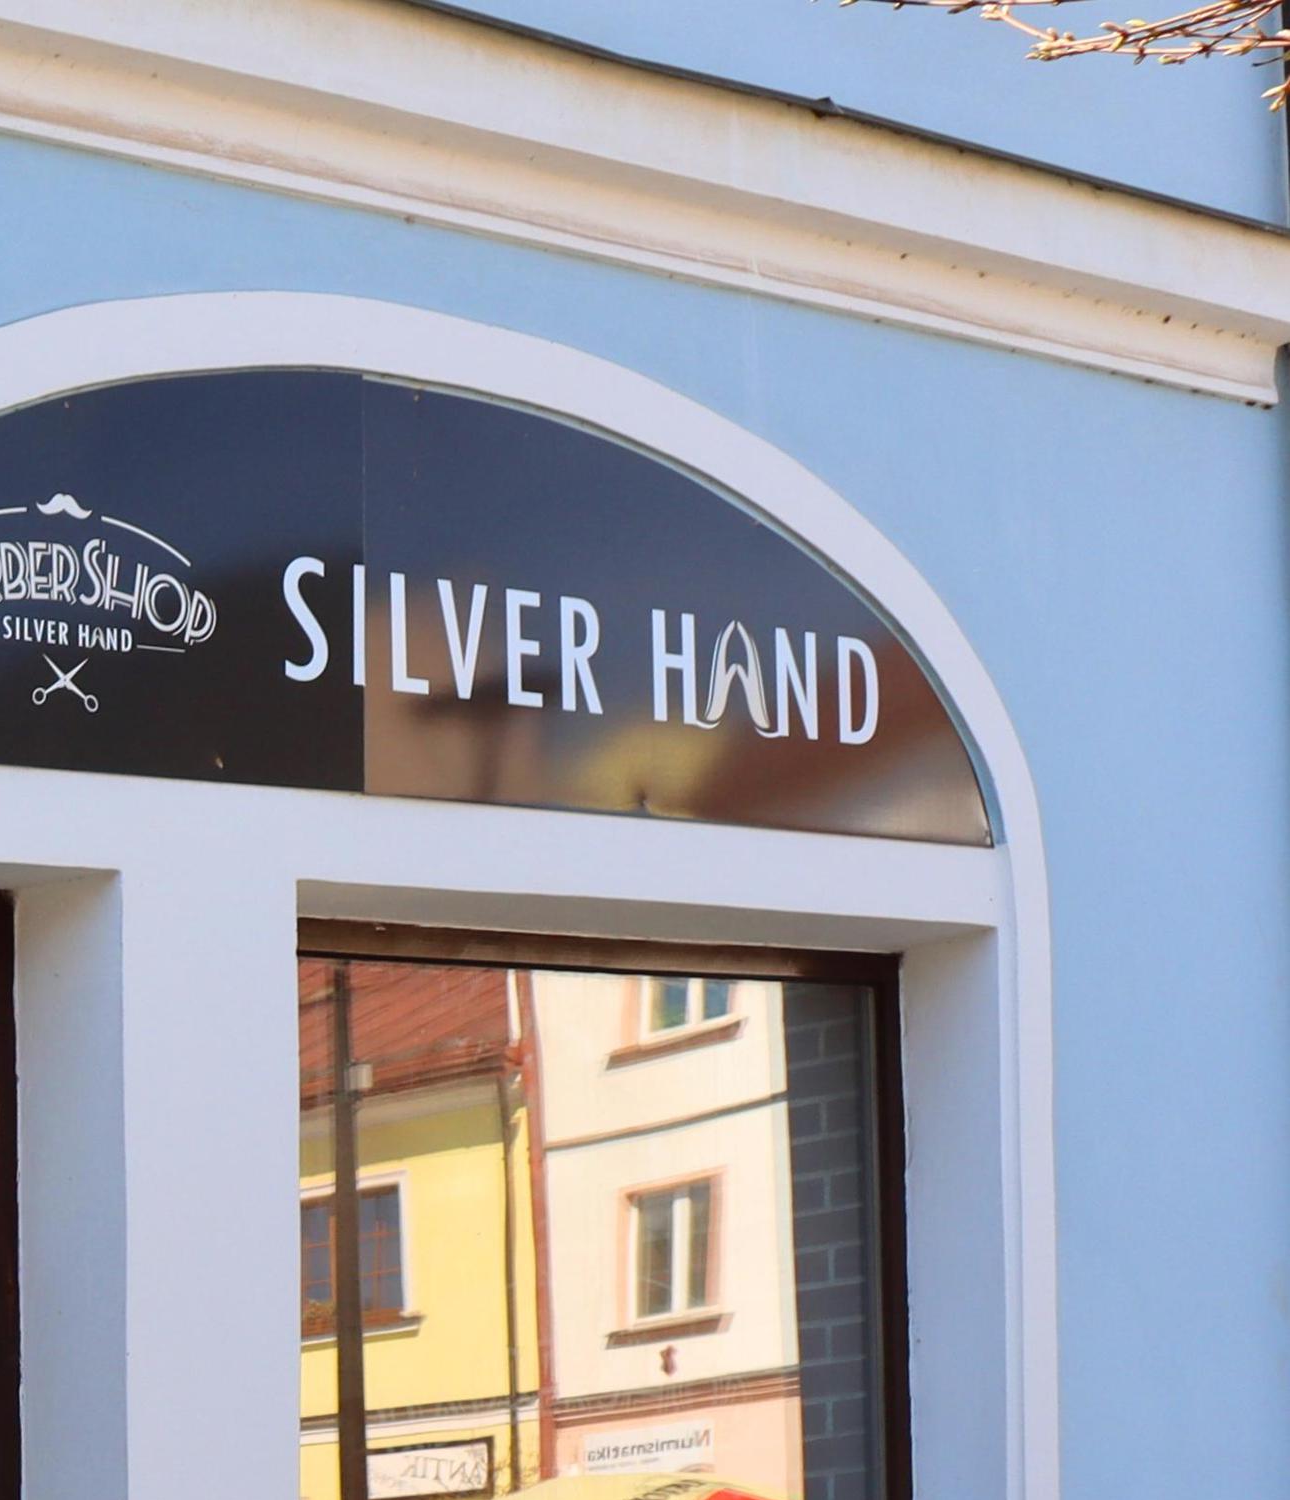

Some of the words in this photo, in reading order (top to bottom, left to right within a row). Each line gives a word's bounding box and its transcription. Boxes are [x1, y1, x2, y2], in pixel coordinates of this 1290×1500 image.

[2, 615, 69, 647] SILVER
[77, 624, 133, 653] HAND
[283, 556, 603, 716] SILVER
[651, 607, 880, 746] HAND
